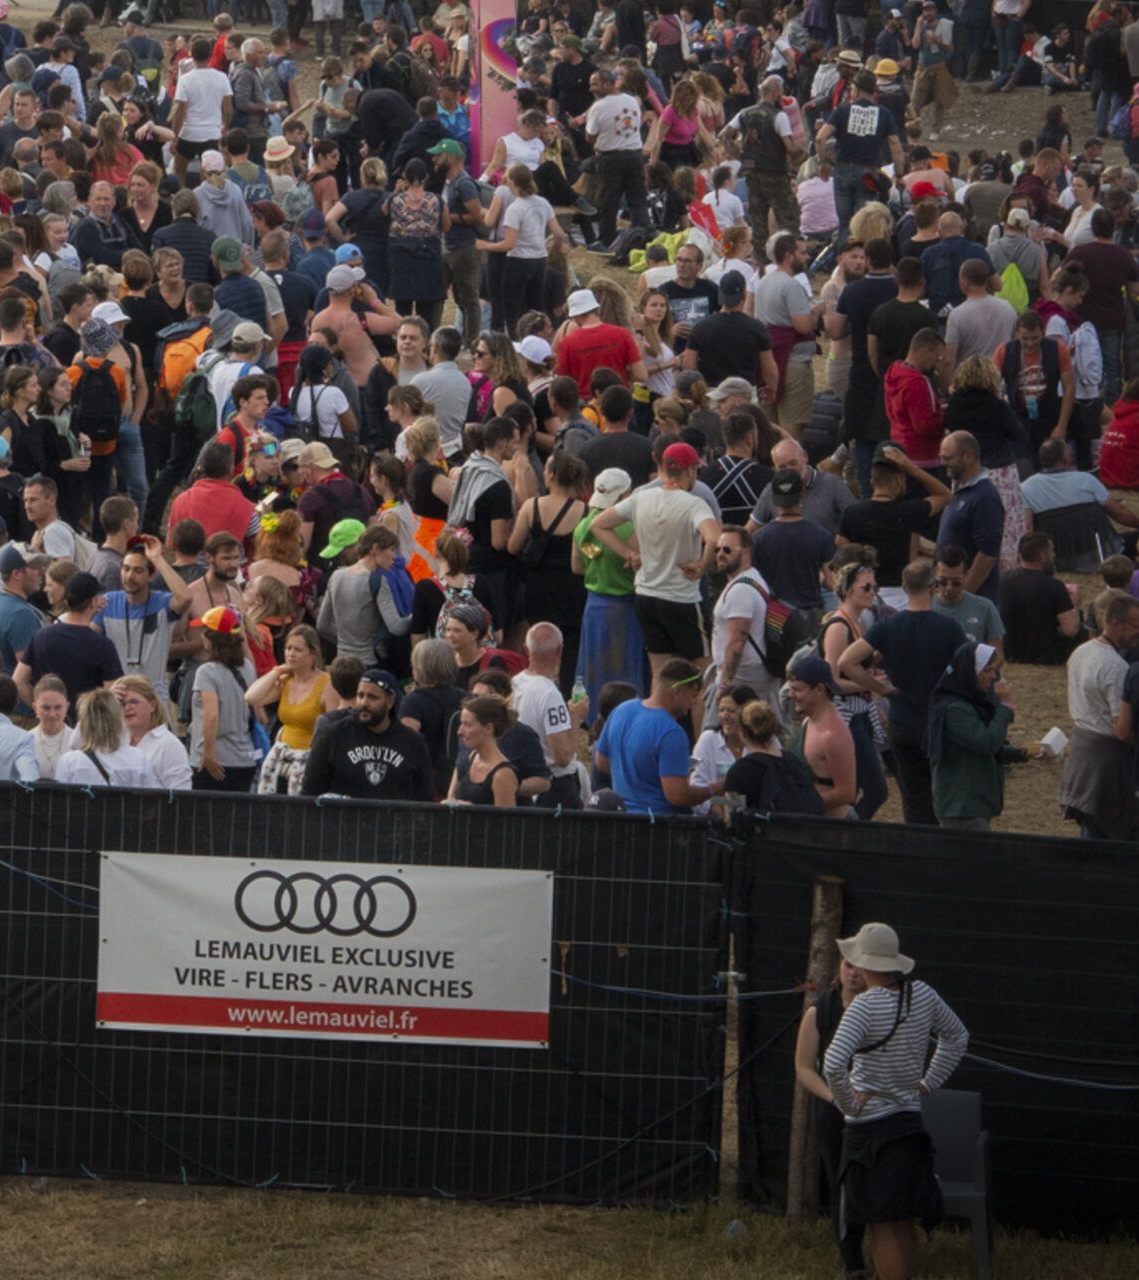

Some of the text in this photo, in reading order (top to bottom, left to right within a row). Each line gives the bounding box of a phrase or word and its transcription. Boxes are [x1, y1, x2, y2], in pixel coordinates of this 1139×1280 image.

[547, 705, 567, 726] 68
[195, 939, 455, 969] LEMAUVIEL EXCLUSIVE
[175, 968, 226, 988] VIRE
[245, 971, 312, 992] FLERS
[332, 976, 474, 999] AVRANCHES
[227, 1005, 418, 1030] www.lemauviel.fr
